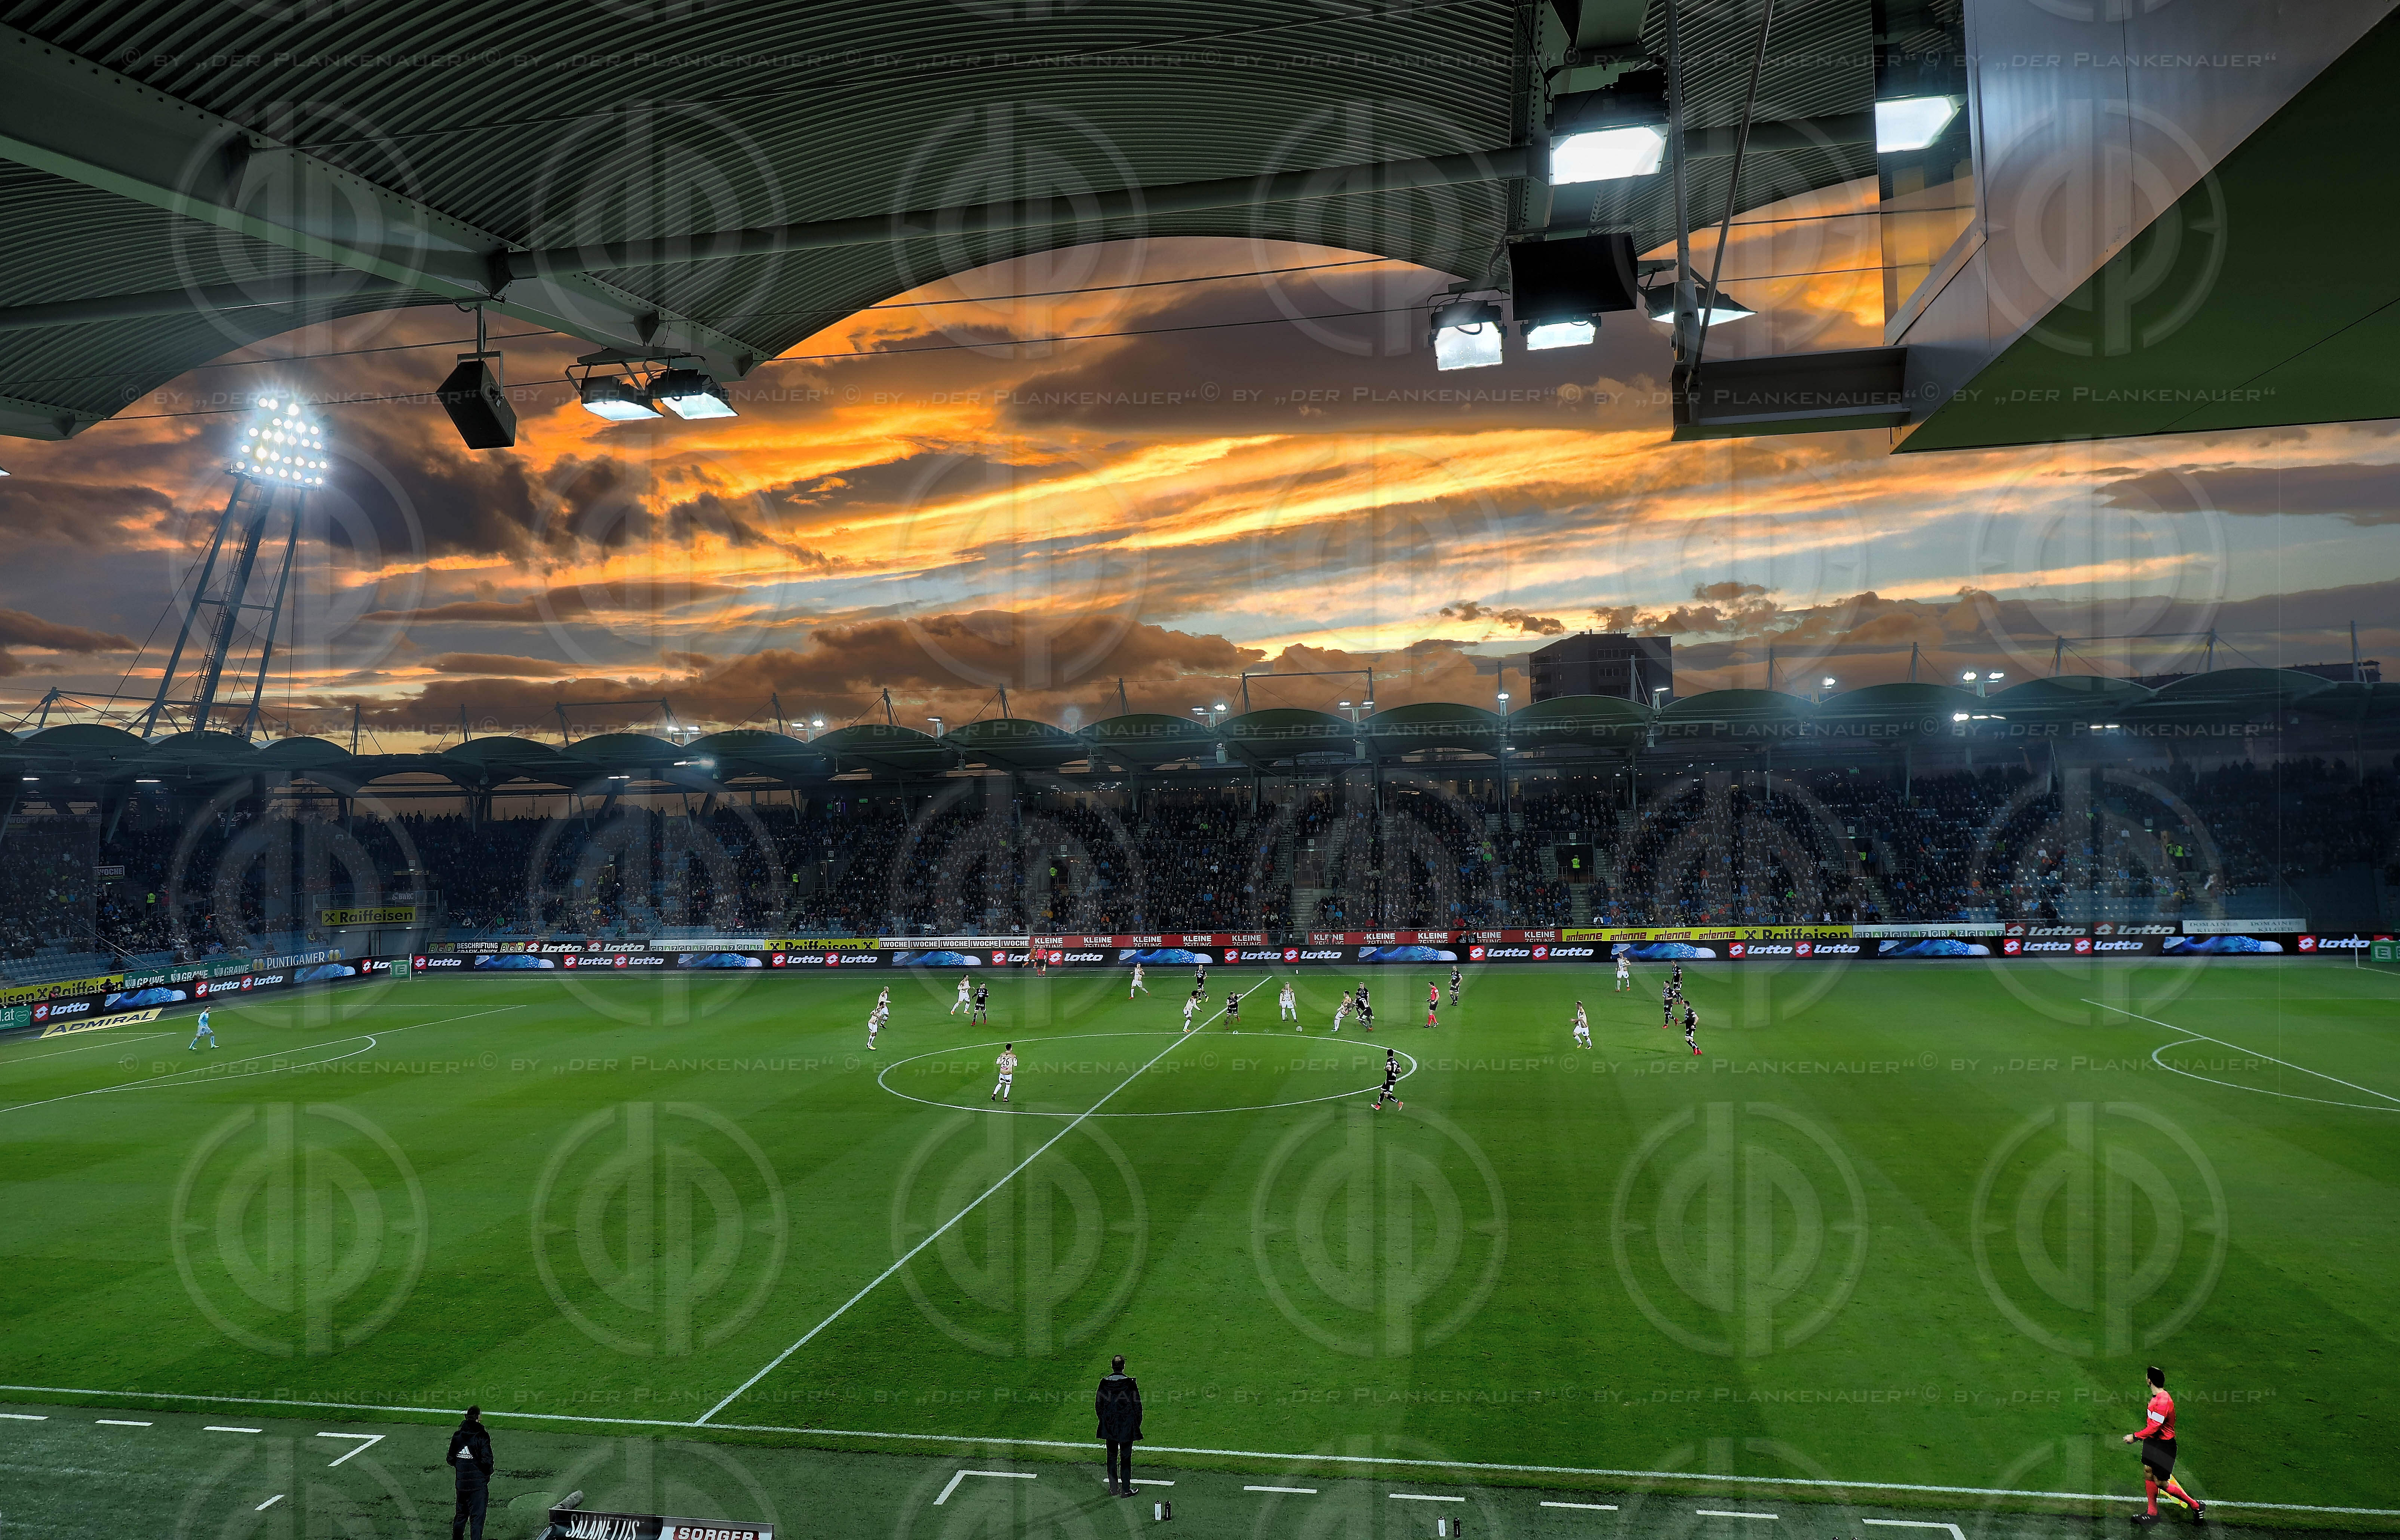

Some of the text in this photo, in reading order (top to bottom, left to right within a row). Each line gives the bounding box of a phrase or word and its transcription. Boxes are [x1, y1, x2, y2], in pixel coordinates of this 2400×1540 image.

[340, 910, 412, 923] Raiffeisen
[1610, 930, 1647, 940] antenne
[1654, 930, 1691, 940] antenne
[1699, 929, 1736, 940] antenne
[2028, 926, 2087, 936] lotto
[2117, 925, 2176, 935] lotto
[1566, 931, 1602, 941] antenne
[542, 943, 583, 952] lotto
[604, 943, 645, 951] lotto
[2023, 941, 2072, 952] lotto
[2094, 941, 2143, 950] lotto
[2318, 938, 2370, 948] lotto
[1487, 948, 1530, 957] lotto
[1549, 947, 1594, 956] lotto
[1747, 945, 1793, 954] lotto
[1814, 944, 1860, 953] lotto
[1064, 953, 1103, 962] lotto
[1241, 951, 1282, 960] lotto
[1301, 950, 1342, 959] lotto
[267, 952, 325, 969] PUNTIGAMER
[787, 956, 823, 964] lotto
[224, 964, 249, 974] GRAWE
[253, 975, 283, 986] lotto
[209, 981, 240, 992] lotto
[50, 1002, 90, 1016] lotto
[45, 1011, 150, 1036] ADMIRAL
[1002, 1057, 1010, 1066] 26
